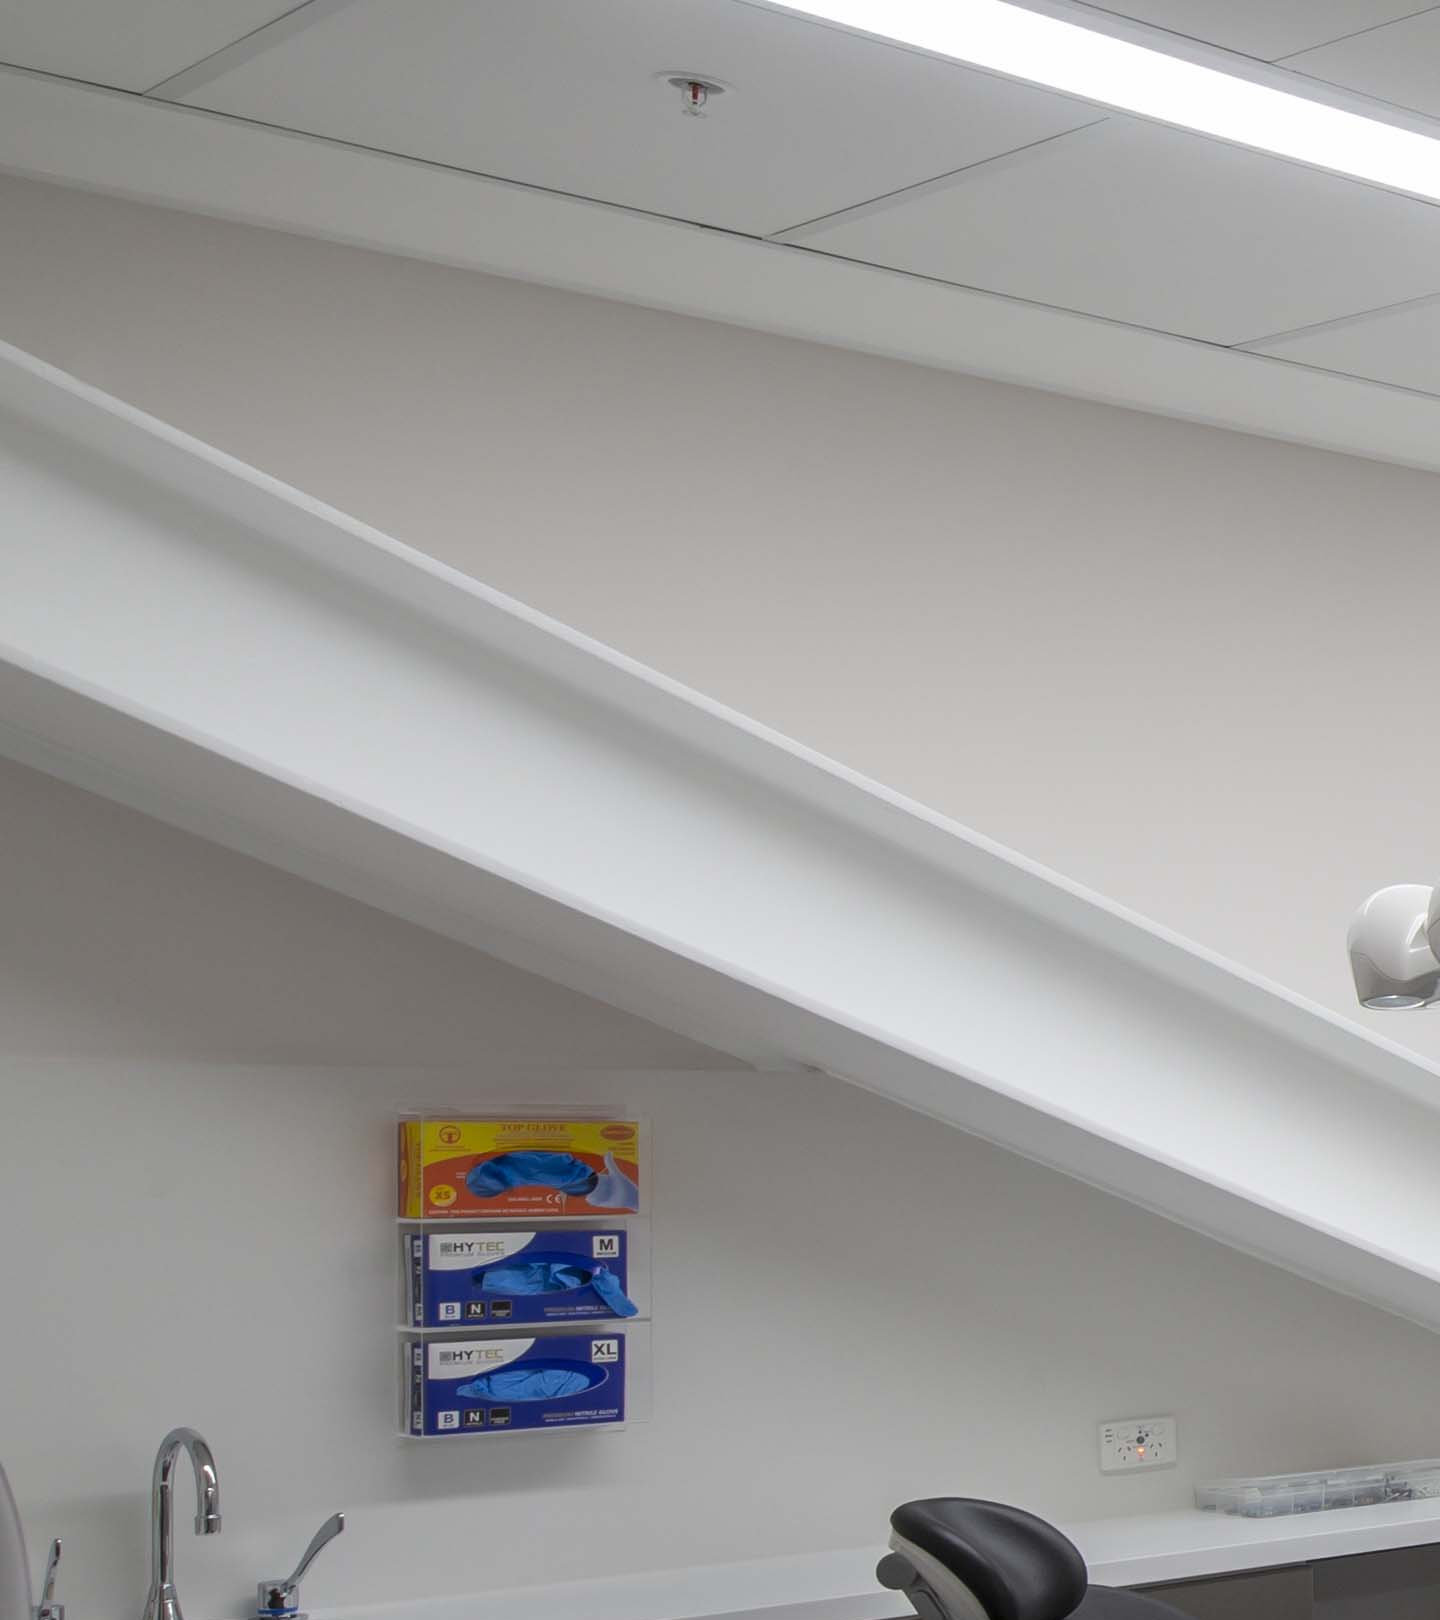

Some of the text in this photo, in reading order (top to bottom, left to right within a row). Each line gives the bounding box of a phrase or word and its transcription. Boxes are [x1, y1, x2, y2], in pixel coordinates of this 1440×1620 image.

[501, 1123, 521, 1132] TOP
[435, 1190, 452, 1200] XS
[453, 1241, 505, 1252] HYTEC
[599, 1238, 614, 1251] M
[445, 1304, 455, 1314] B
[470, 1303, 482, 1314] N
[453, 1349, 505, 1361] HYTEC
[593, 1343, 617, 1357] XL
[444, 1414, 454, 1424] B
[469, 1412, 481, 1422] N
